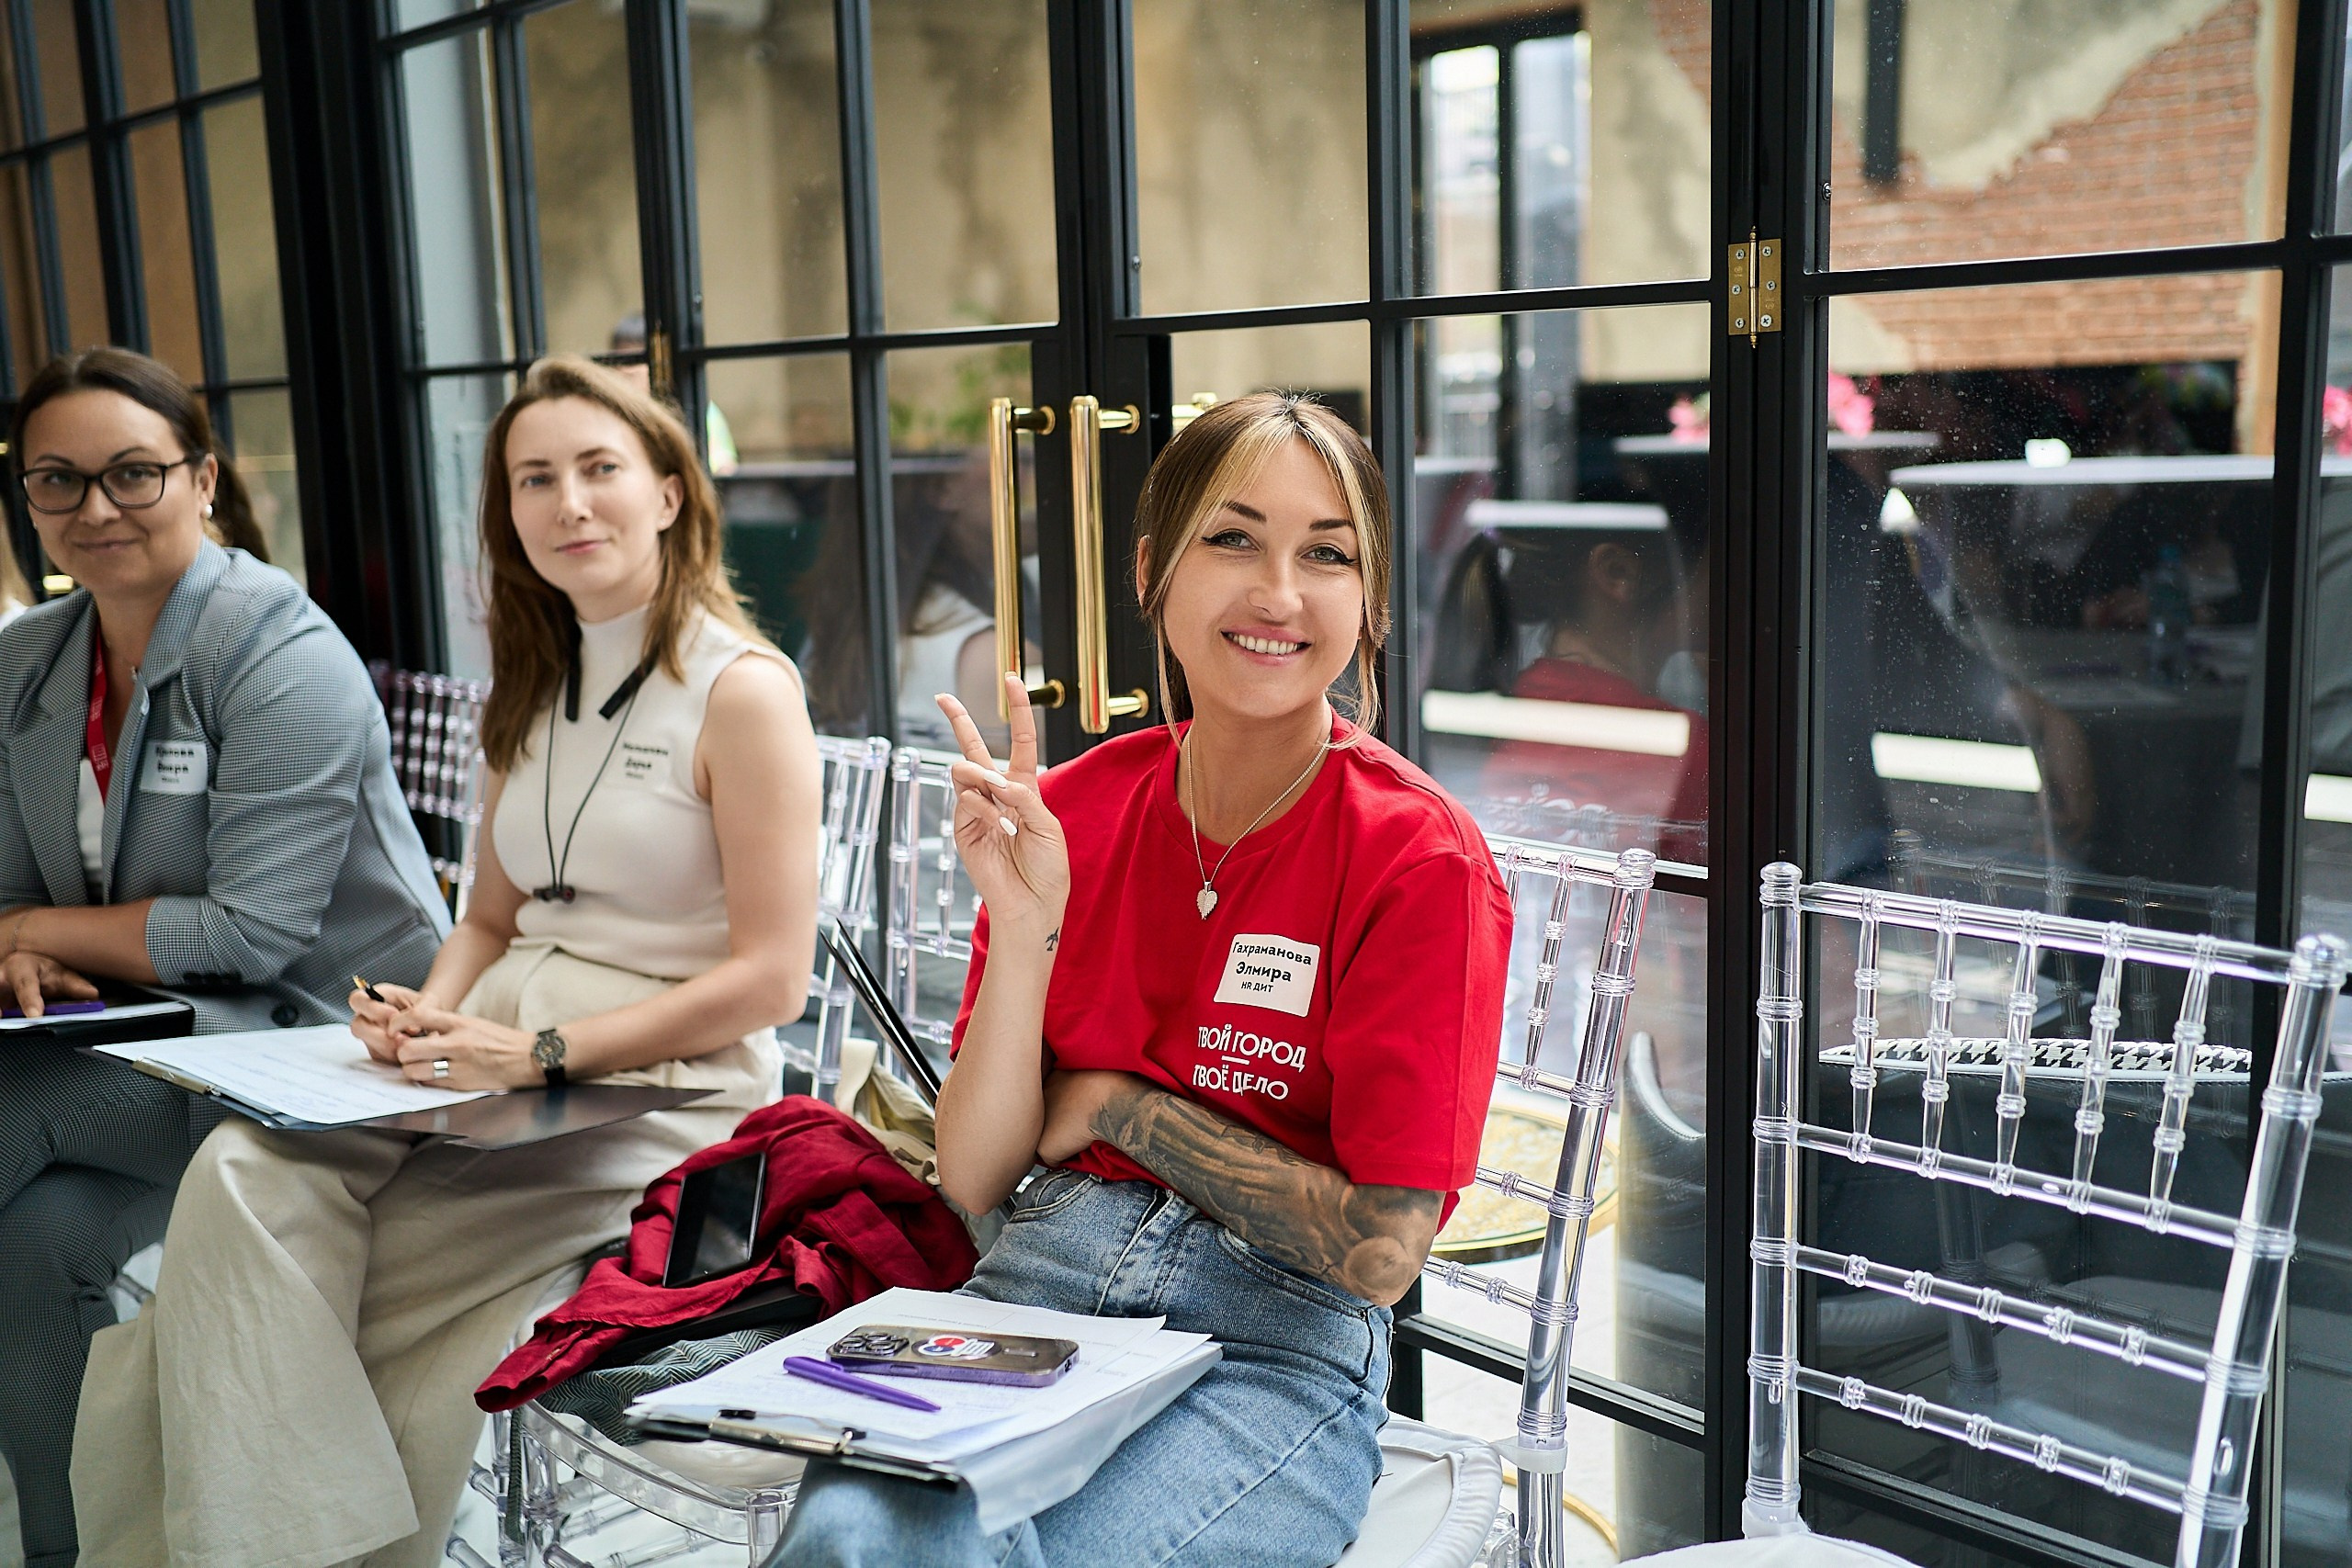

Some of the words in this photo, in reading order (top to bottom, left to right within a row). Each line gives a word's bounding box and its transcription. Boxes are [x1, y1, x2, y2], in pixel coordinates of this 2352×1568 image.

[1232, 942, 1312, 965] Гахраманова
[1236, 961, 1292, 983] Элмира
[1240, 980, 1252, 990] HR
[1253, 982, 1274, 993] ДИТ
[1197, 1023, 1233, 1052] ТВОЙ
[1232, 1031, 1307, 1073] ГОРОД
[1193, 1064, 1230, 1091] ТВОЁ
[1232, 1071, 1289, 1100] ДЕЛО
